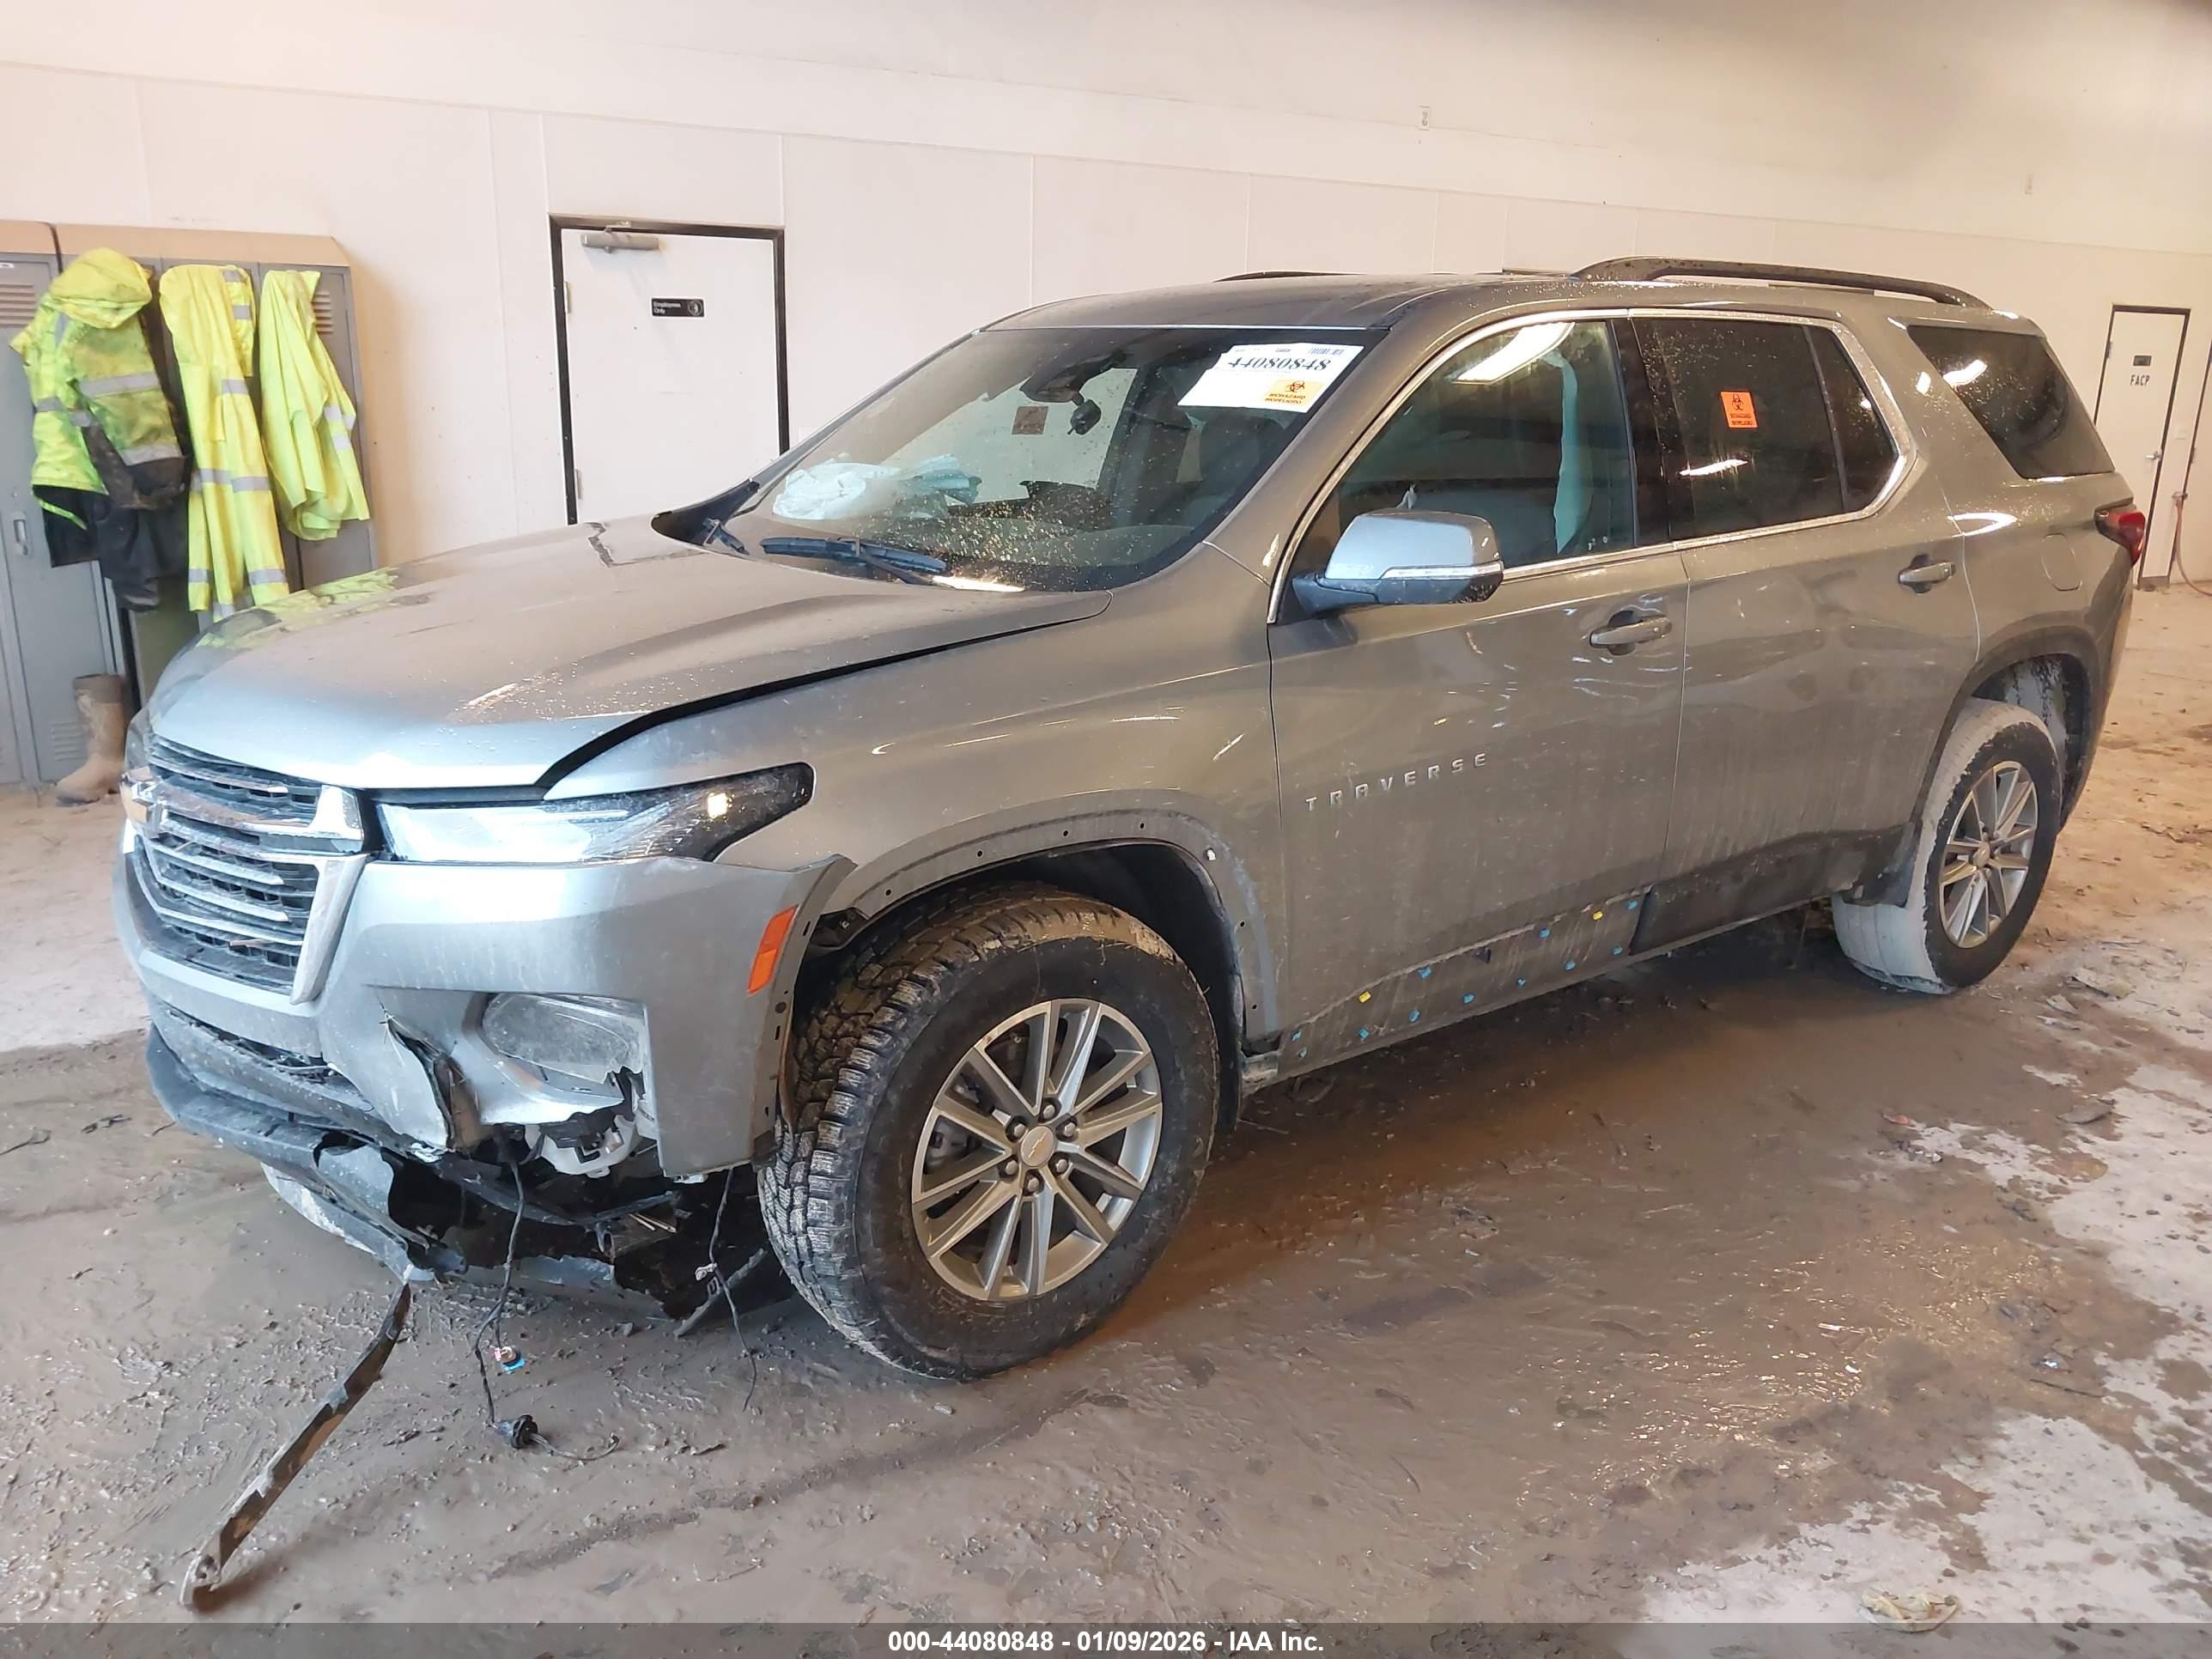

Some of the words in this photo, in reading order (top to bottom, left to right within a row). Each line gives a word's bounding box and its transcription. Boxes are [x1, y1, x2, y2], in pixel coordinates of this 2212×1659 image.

[1227, 356, 1332, 371] 44080848
[2130, 374, 2151, 386] FACP
[1304, 752, 1487, 811] TRAVERSE
